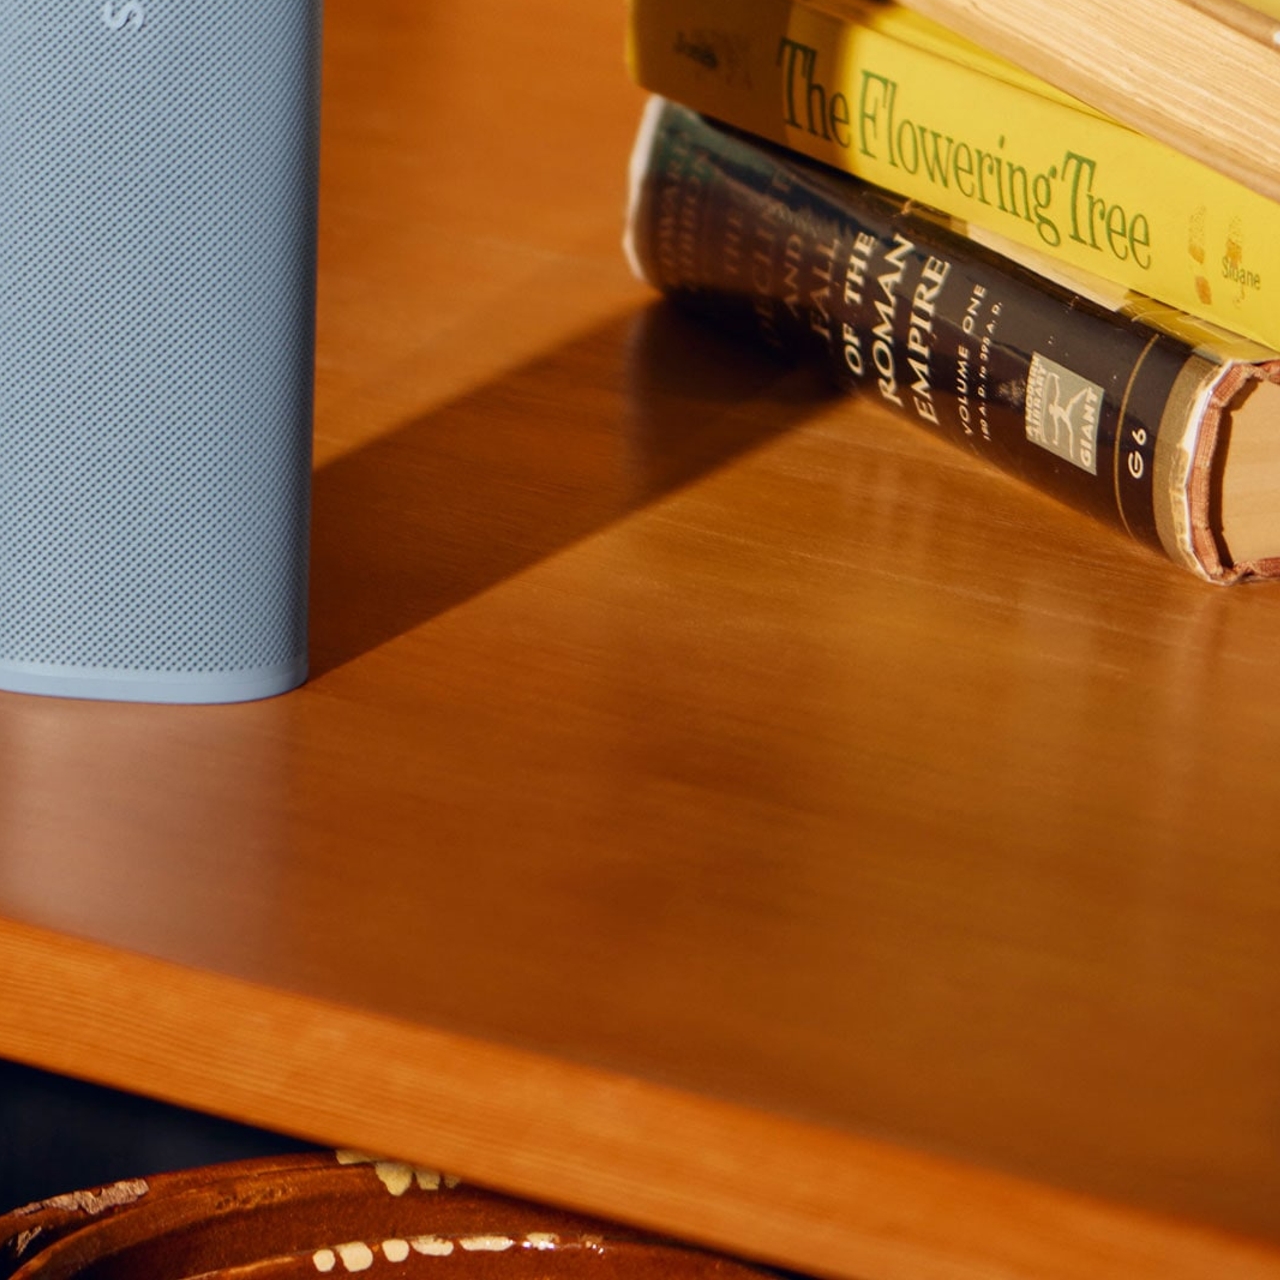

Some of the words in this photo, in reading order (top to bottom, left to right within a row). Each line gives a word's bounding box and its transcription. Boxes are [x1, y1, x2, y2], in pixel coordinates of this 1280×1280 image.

[777, 37, 853, 148] The
[858, 69, 1062, 247] Flowering
[1063, 151, 1152, 272] Tree
[724, 215, 744, 277] THE
[782, 233, 804, 318] AND
[844, 232, 877, 306] THE
[1221, 255, 1262, 291] Sloane
[809, 237, 841, 341] FALL
[871, 232, 916, 408] ROMAN
[961, 282, 987, 336] ONE
[990, 301, 1003, 316] D.
[842, 322, 865, 376] OF
[906, 255, 952, 426] EMPIRE
[985, 319, 997, 334] A.
[955, 344, 974, 436] VOLUME
[1024, 353, 1040, 423] MODERN
[1031, 363, 1048, 436] LIBRARY
[1080, 386, 1099, 468] GIANT
[1130, 427, 1148, 446] 6
[1127, 450, 1145, 480] G
